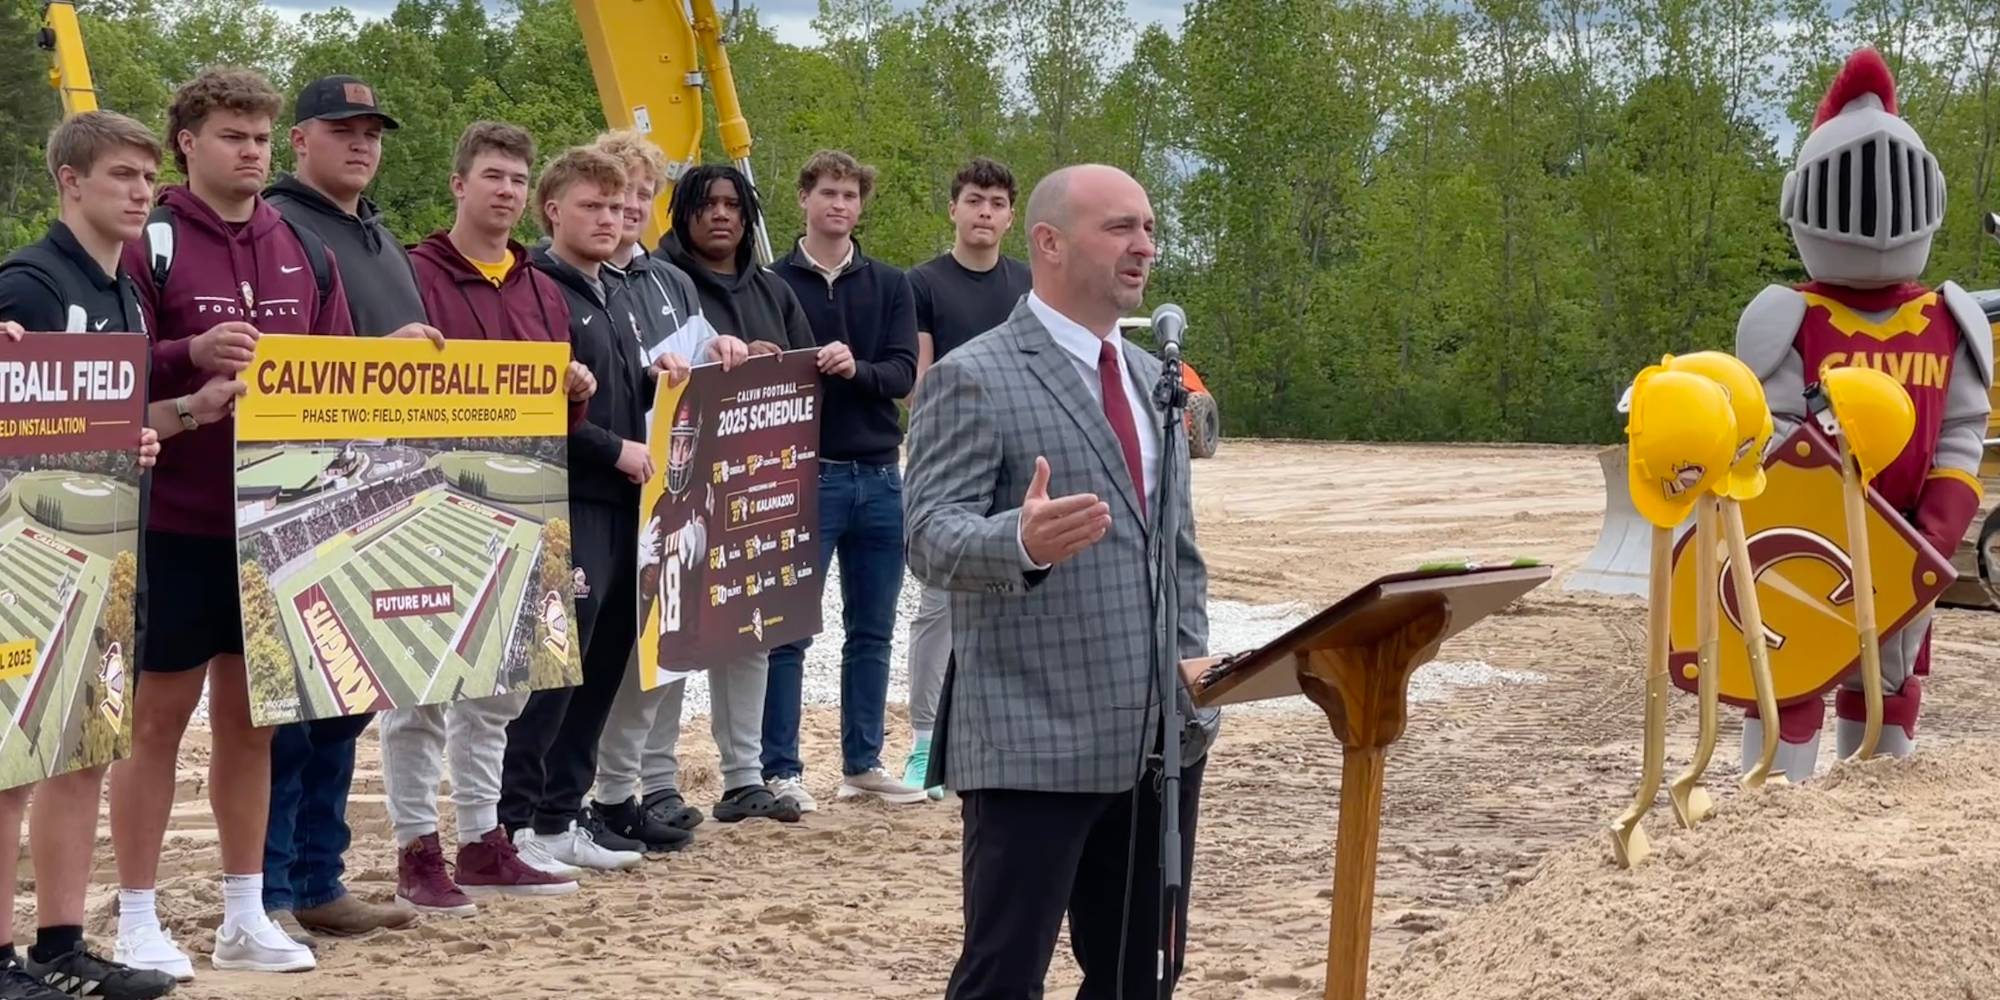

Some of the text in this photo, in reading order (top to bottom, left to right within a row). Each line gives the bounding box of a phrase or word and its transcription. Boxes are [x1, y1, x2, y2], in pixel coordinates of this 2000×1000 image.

[73, 361, 135, 400] FIELD
[257, 360, 557, 395] CALVIN FOOTBALL FIELD
[737, 382, 797, 403] CALVIN FOOTBALL
[302, 408, 517, 424] PHASE TWO: FIELD, STANDS, SCOREBOARD
[717, 396, 814, 437] 2025 SCHEDULE
[19, 417, 86, 436] INSTALLATION
[756, 493, 795, 512] KALAMAZOO
[376, 592, 450, 612] FUTURE PLAN
[8, 648, 32, 668] 2025
